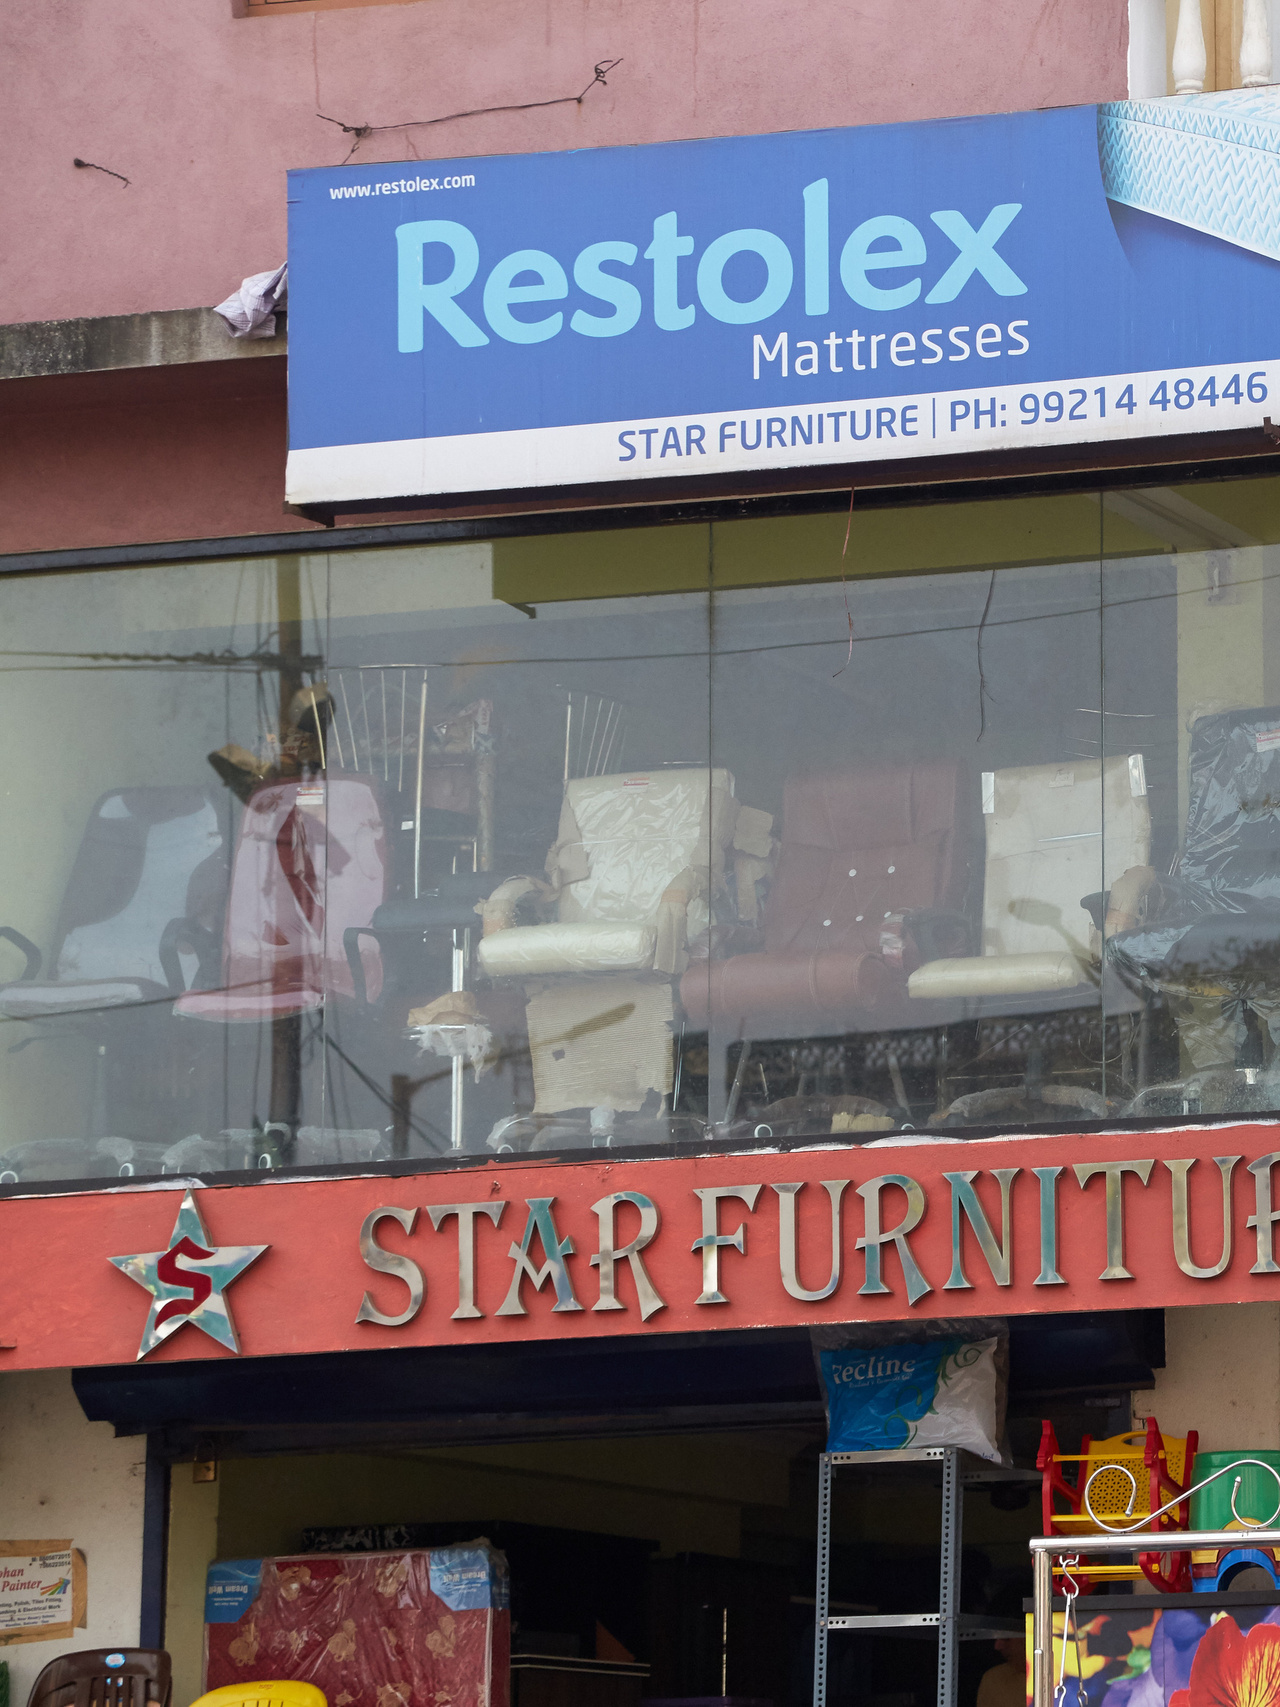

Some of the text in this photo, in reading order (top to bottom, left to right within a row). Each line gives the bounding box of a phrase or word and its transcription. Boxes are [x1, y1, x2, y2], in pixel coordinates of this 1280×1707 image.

[329, 171, 475, 200] www.restolex.com
[395, 178, 1028, 353] Restolex
[754, 319, 1030, 380] Mattresses
[618, 371, 1268, 462] STAR FURNITURE PH: 99214 48446
[354, 1190, 667, 1328] STAR
[1, 1579, 43, 1593] Painter
